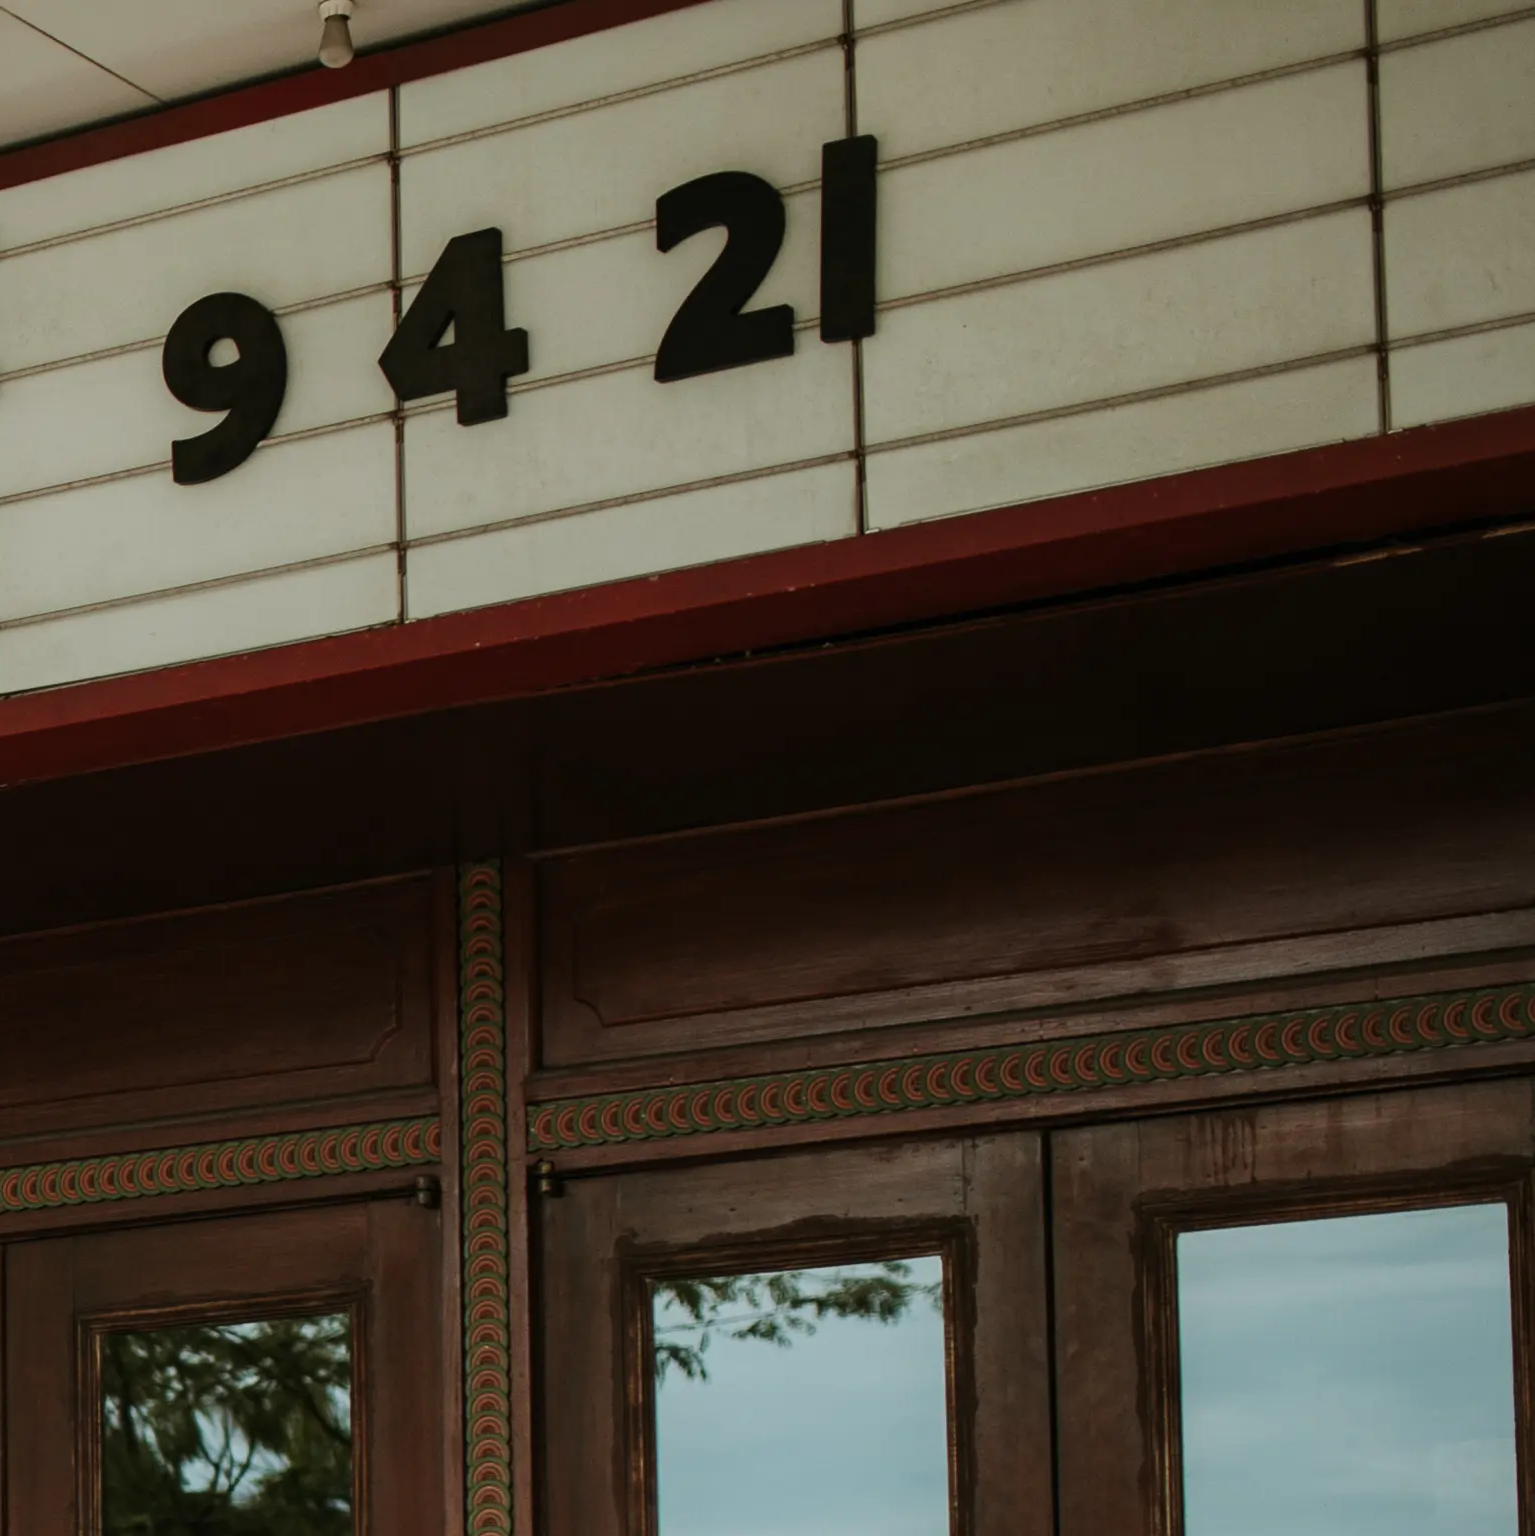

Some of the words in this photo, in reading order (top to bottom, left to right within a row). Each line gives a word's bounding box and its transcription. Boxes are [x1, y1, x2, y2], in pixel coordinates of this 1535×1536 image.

[161, 291, 288, 486] 9
[377, 226, 531, 428] 4
[654, 133, 879, 384] 21
